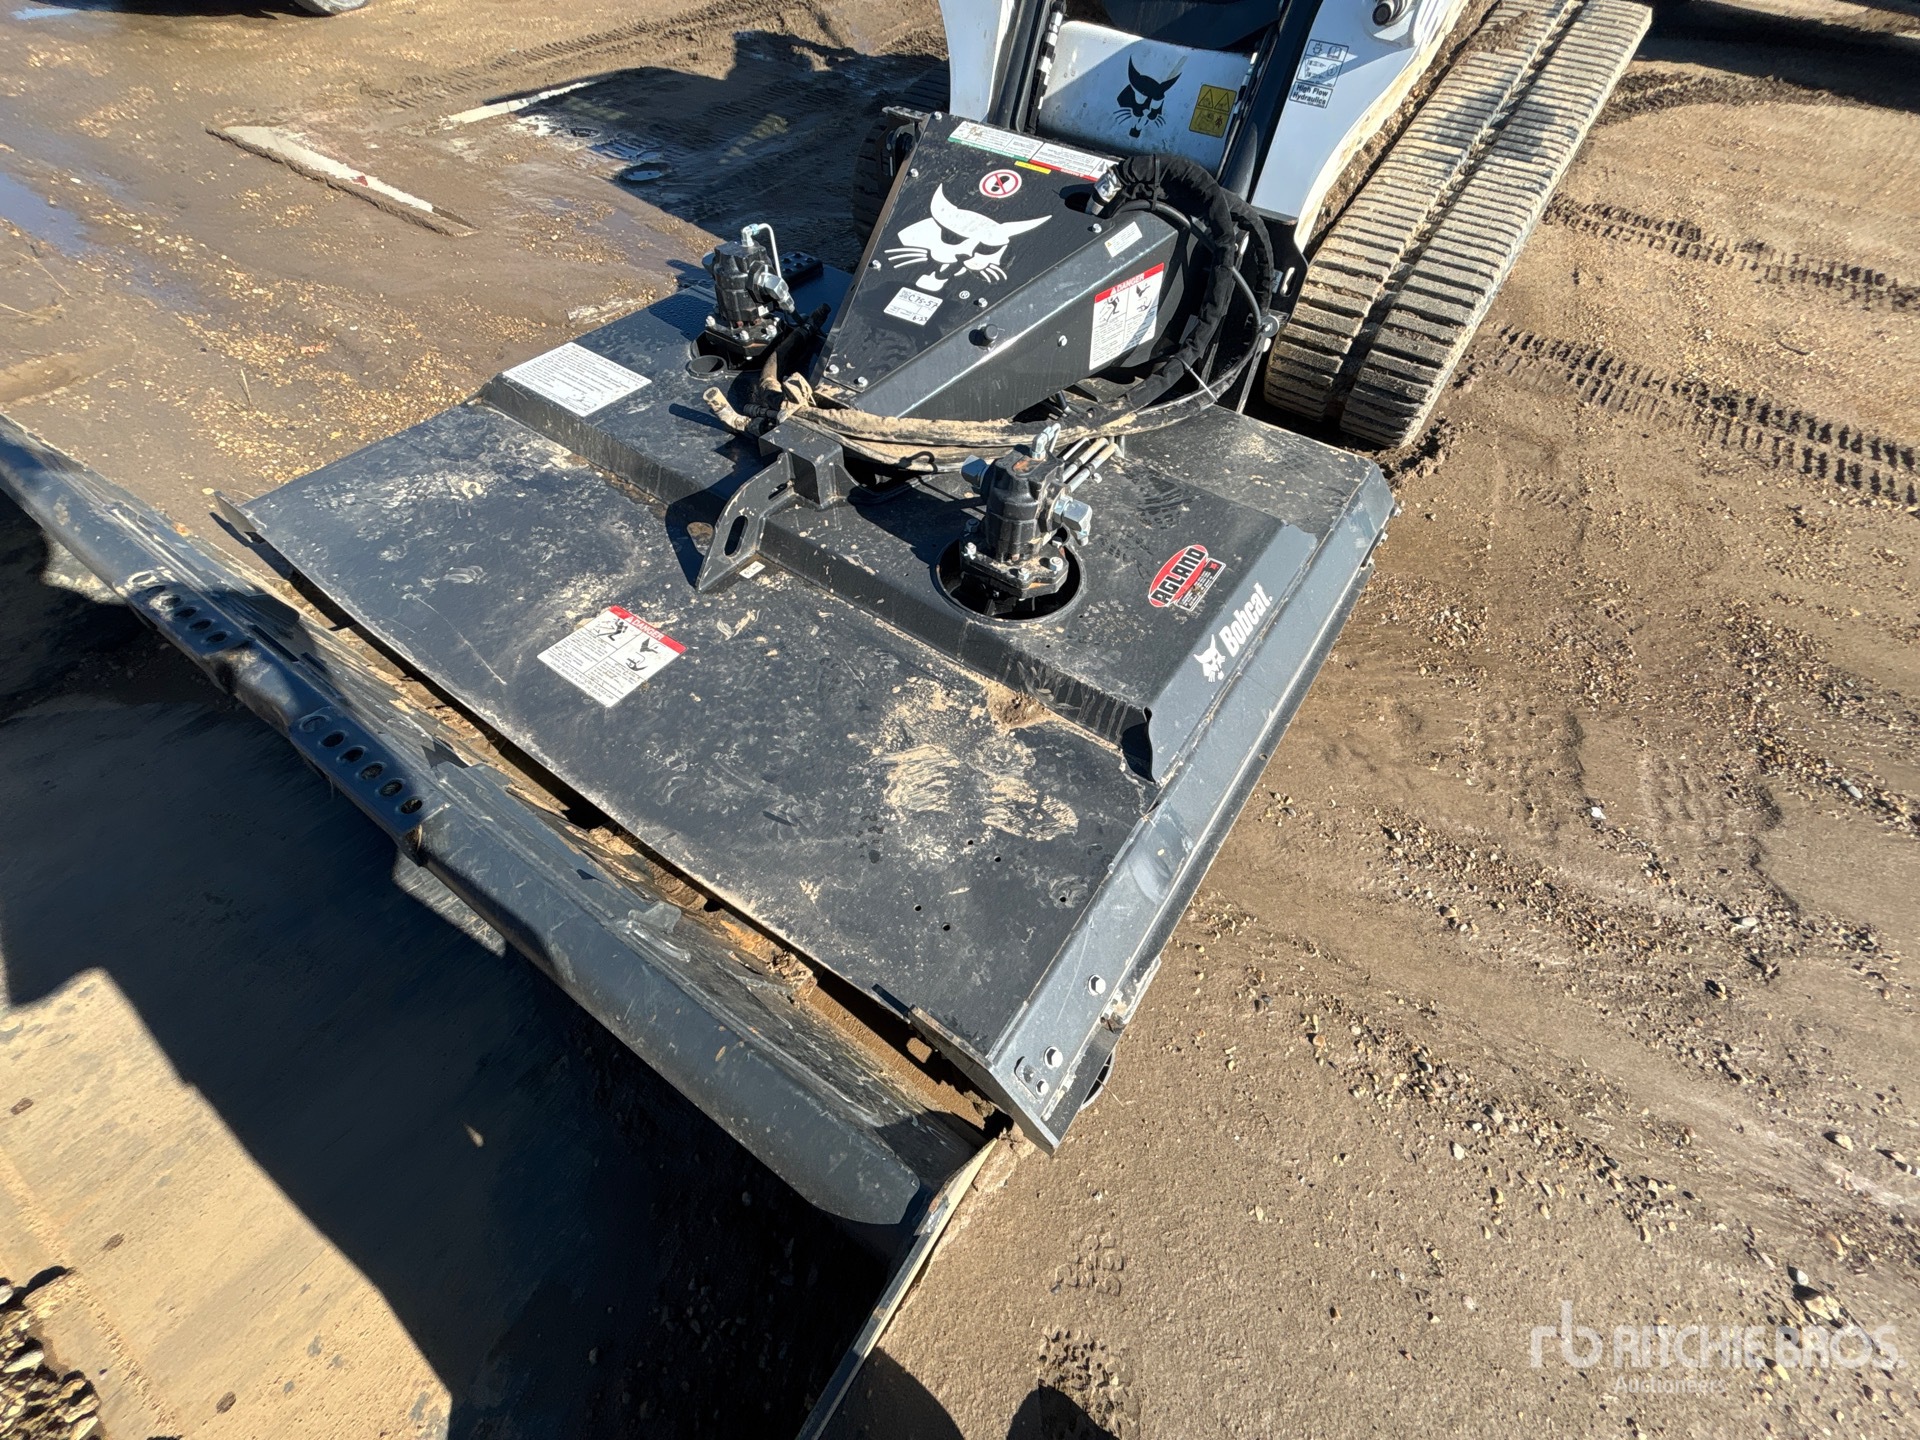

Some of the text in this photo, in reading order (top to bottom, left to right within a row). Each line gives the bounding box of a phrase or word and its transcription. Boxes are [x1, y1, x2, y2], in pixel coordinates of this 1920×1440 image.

[1292, 91, 1327, 106] Hydraulics
[1296, 84, 1329, 97] High Flow
[1116, 272, 1145, 293] DANGER
[1149, 546, 1208, 606] AGLAND
[630, 618, 665, 641] DANGER
